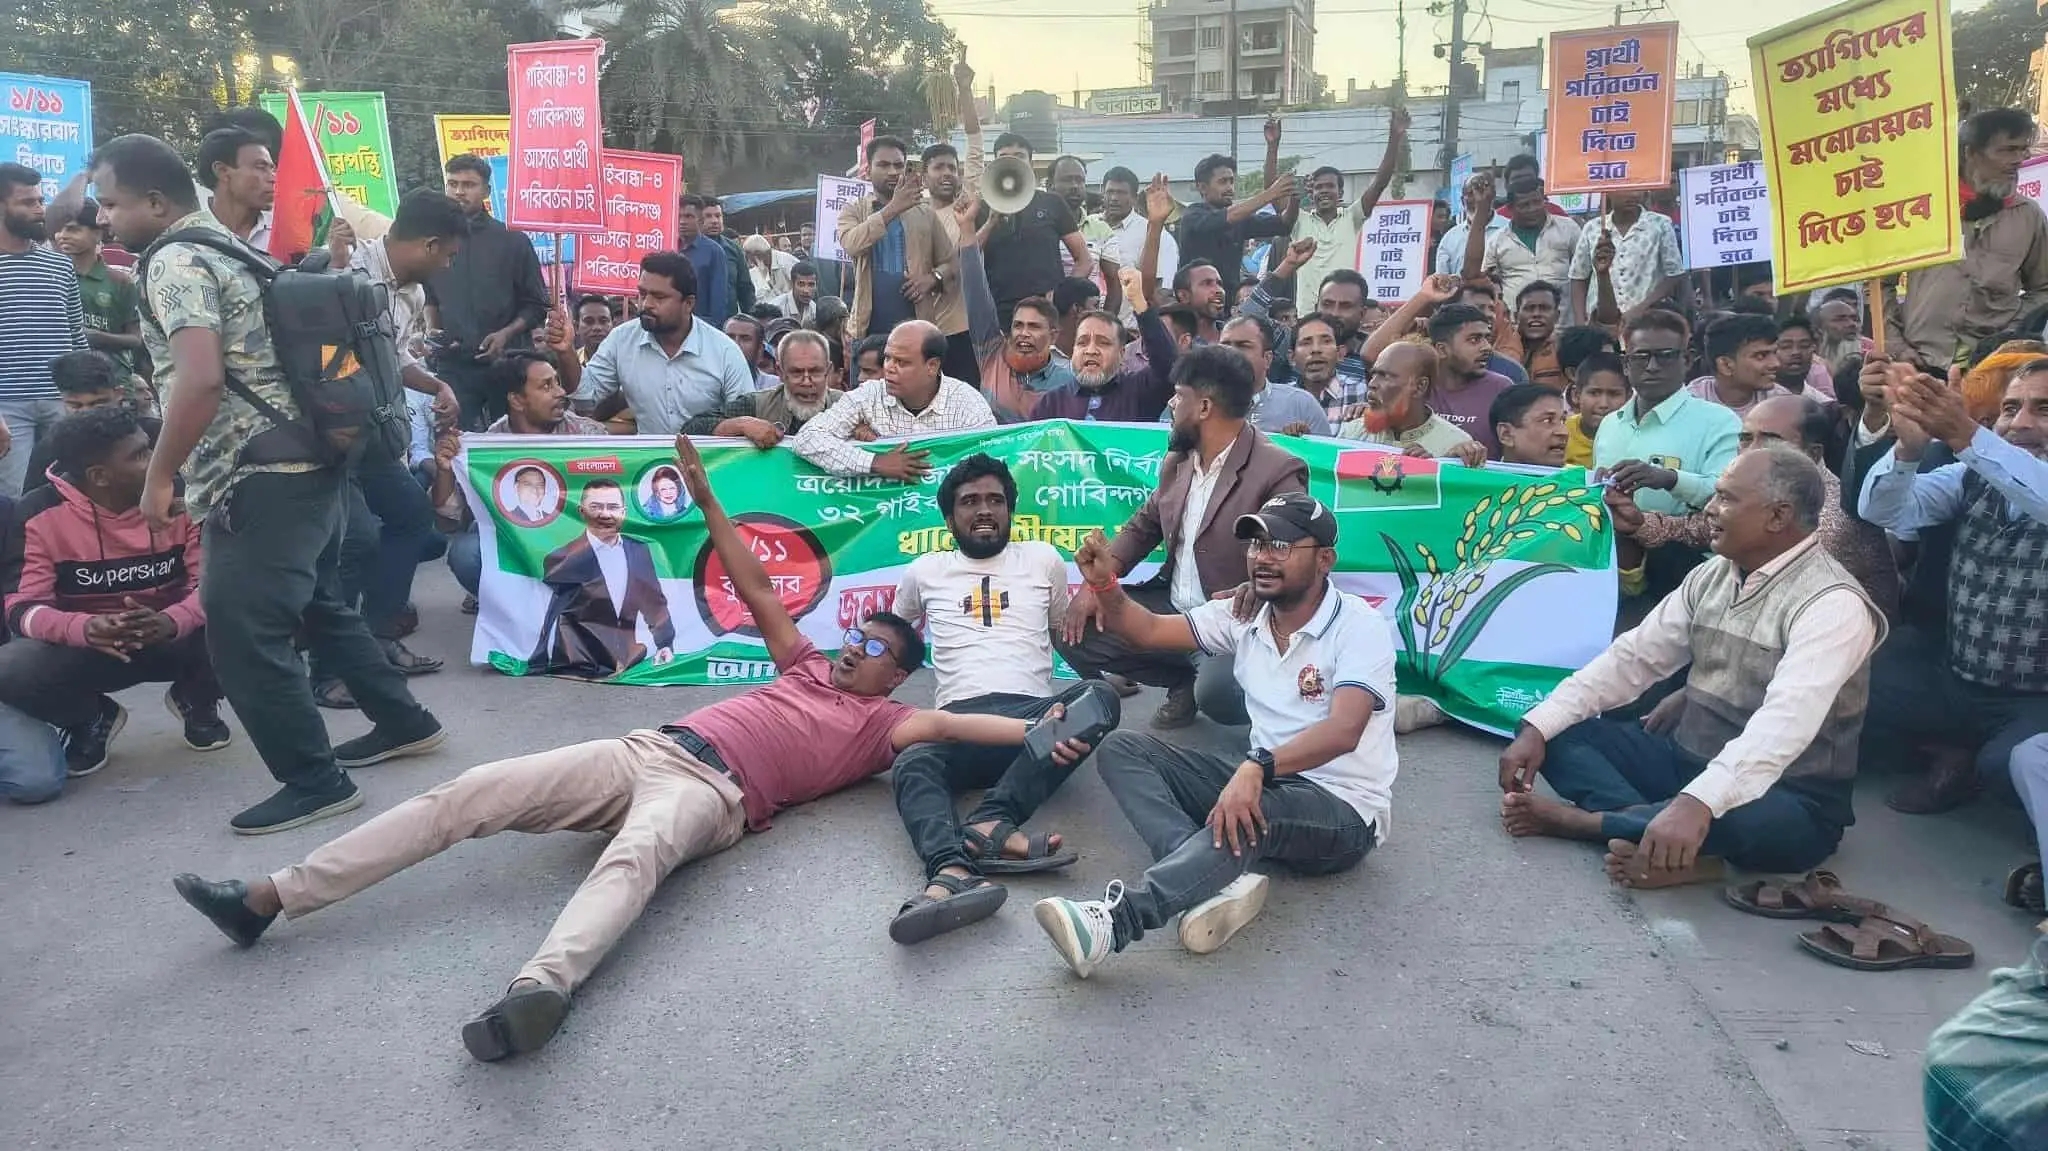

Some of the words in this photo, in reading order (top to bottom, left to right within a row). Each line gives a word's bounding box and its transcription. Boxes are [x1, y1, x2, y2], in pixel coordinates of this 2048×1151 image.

[1586, 38, 1640, 70] প্রার্থী
[1778, 12, 1927, 82] ত্যাগিদের
[526, 60, 586, 89] গাইবান্ধা-৪
[1565, 67, 1660, 100] পরিবর্তন
[10, 86, 63, 114] ১/১১
[1815, 69, 1891, 113] মধ্যে
[311, 101, 361, 135] /১১
[527, 99, 585, 129] গোবিন্দগঞ্জ
[1591, 100, 1630, 123] চাই
[1582, 129, 1637, 152] দিতে
[1787, 102, 1933, 165] মনোনয়ন
[524, 147, 559, 169] আসনে
[562, 141, 589, 169] প্রার্থী
[1587, 162, 1628, 179] হবে
[1710, 160, 1755, 185] প্রার্থী
[1834, 156, 1884, 197] চাই
[520, 181, 571, 211] পরিবর্তন
[575, 184, 595, 213] চাই
[1718, 206, 1751, 223] চাই
[1799, 210, 1865, 248] দিতে
[1873, 193, 1932, 229] হবে
[1367, 227, 1421, 247] পরিবর্তন
[1712, 227, 1759, 244] দিতে
[1380, 248, 1403, 262] চাই
[1720, 248, 1753, 263] হবে
[1374, 264, 1406, 281] দিতে
[1377, 286, 1400, 298] হবে
[794, 474, 889, 495] ত্রয়োদ
[1016, 450, 1097, 473] সংসদ
[1102, 448, 1163, 477] নির্বা
[817, 504, 865, 524] ৩২
[876, 488, 937, 519] গাইব
[1035, 478, 1149, 508] গোবিন্দগ
[751, 535, 788, 562] /১১
[76, 557, 175, 587] Superstar
